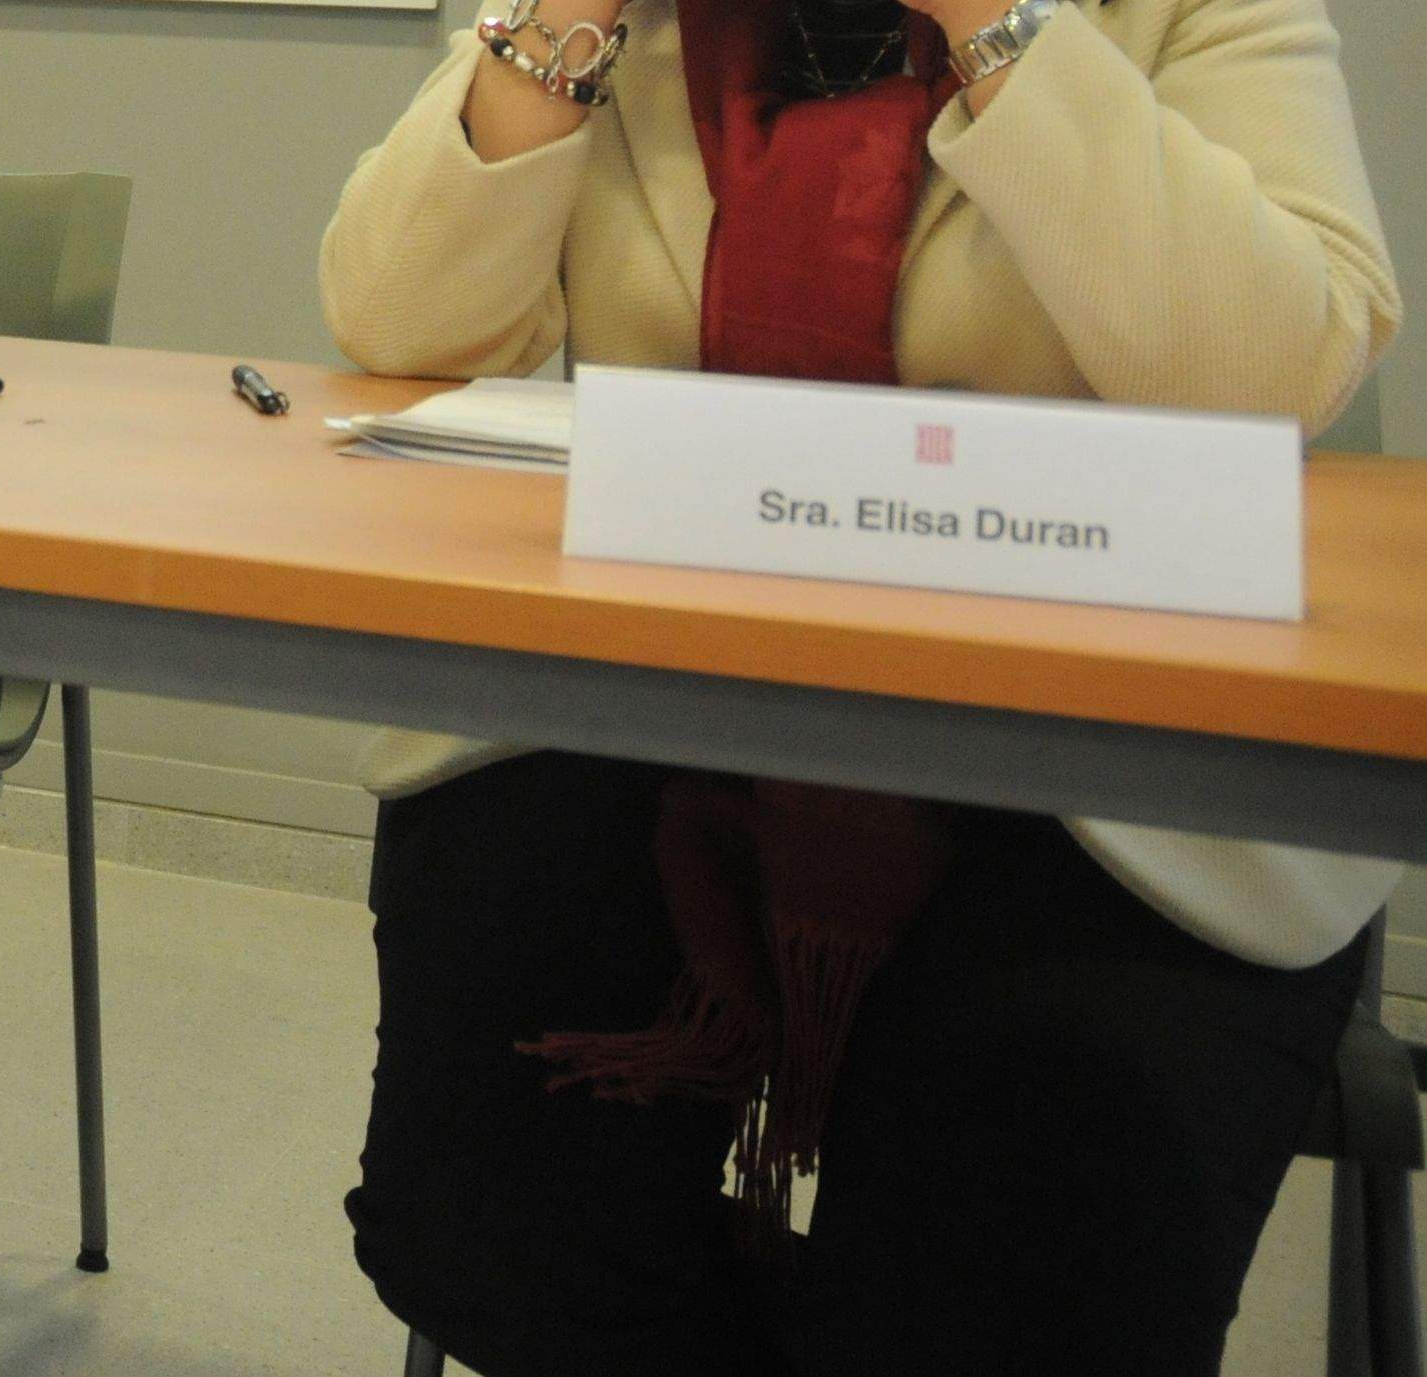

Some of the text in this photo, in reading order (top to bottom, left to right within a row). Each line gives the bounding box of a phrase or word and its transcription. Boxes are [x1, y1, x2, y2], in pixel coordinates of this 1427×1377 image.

[758, 488, 1110, 551] Sra. Elisa Duran
